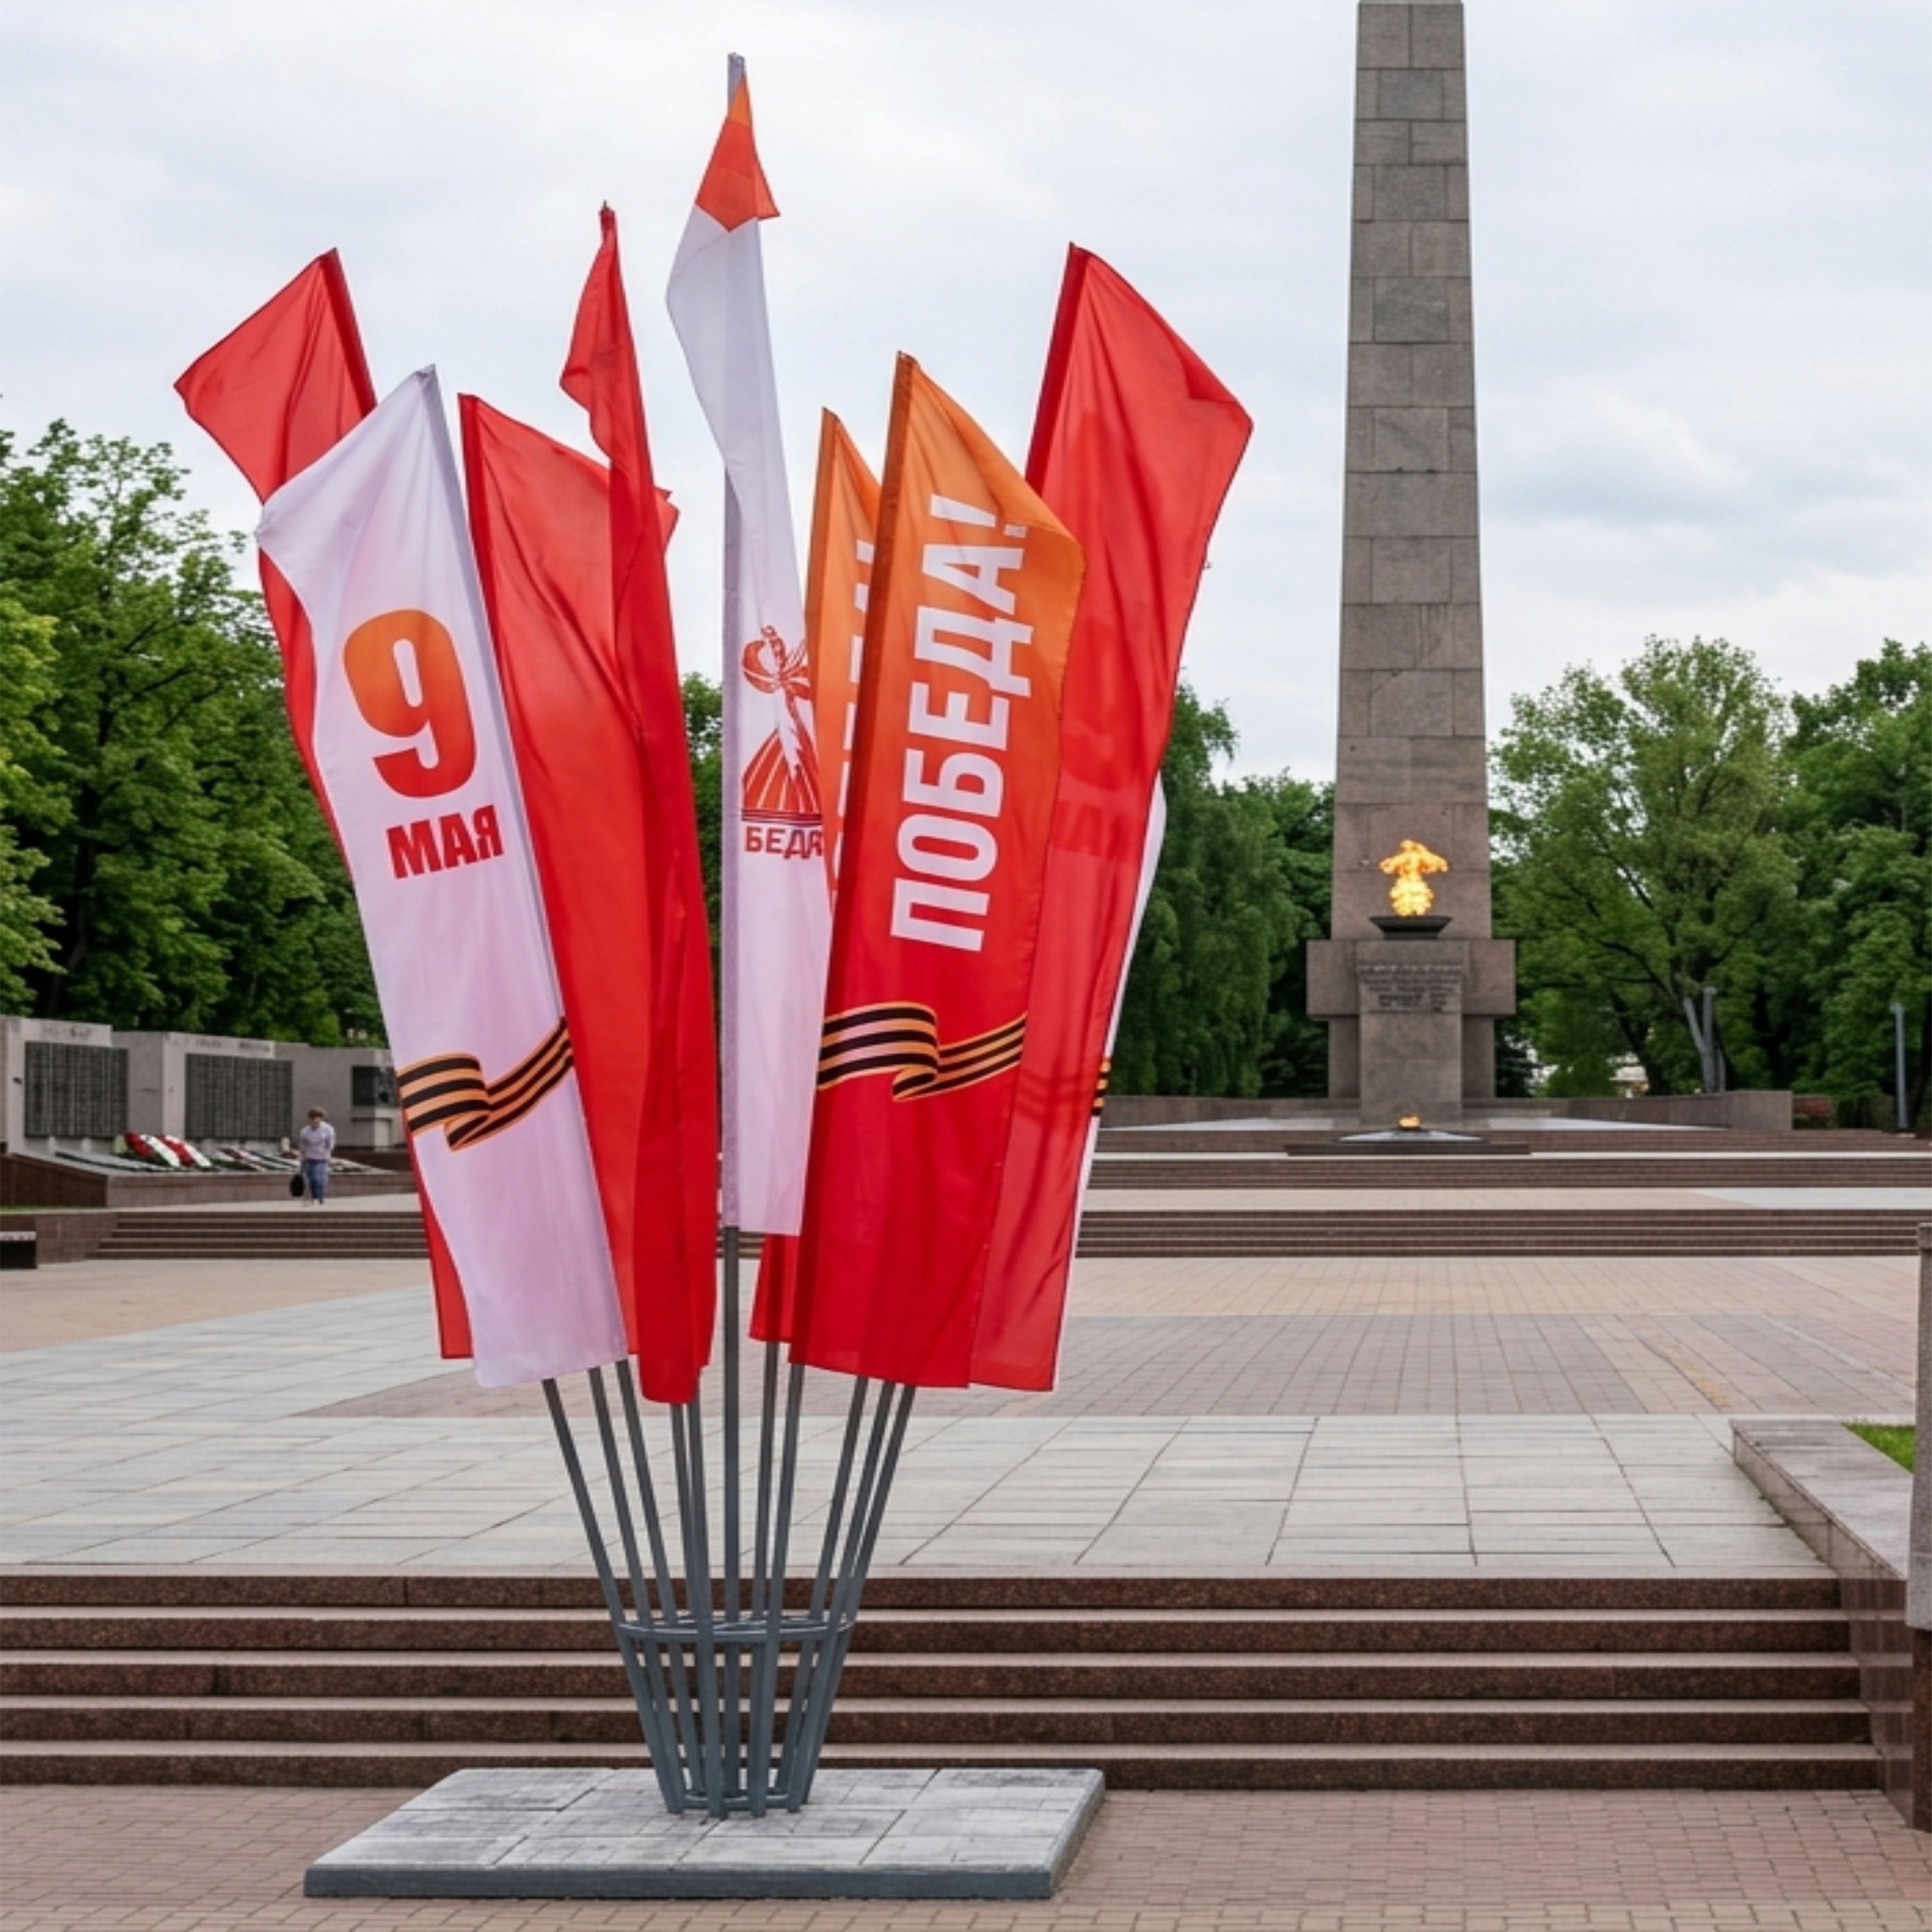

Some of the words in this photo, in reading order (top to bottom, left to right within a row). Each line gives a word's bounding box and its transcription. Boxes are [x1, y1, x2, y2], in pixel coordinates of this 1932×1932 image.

[343, 608, 477, 799] 9
[889, 493, 1034, 952] ПОБЕДА!
[386, 804, 505, 880] МАЯ
